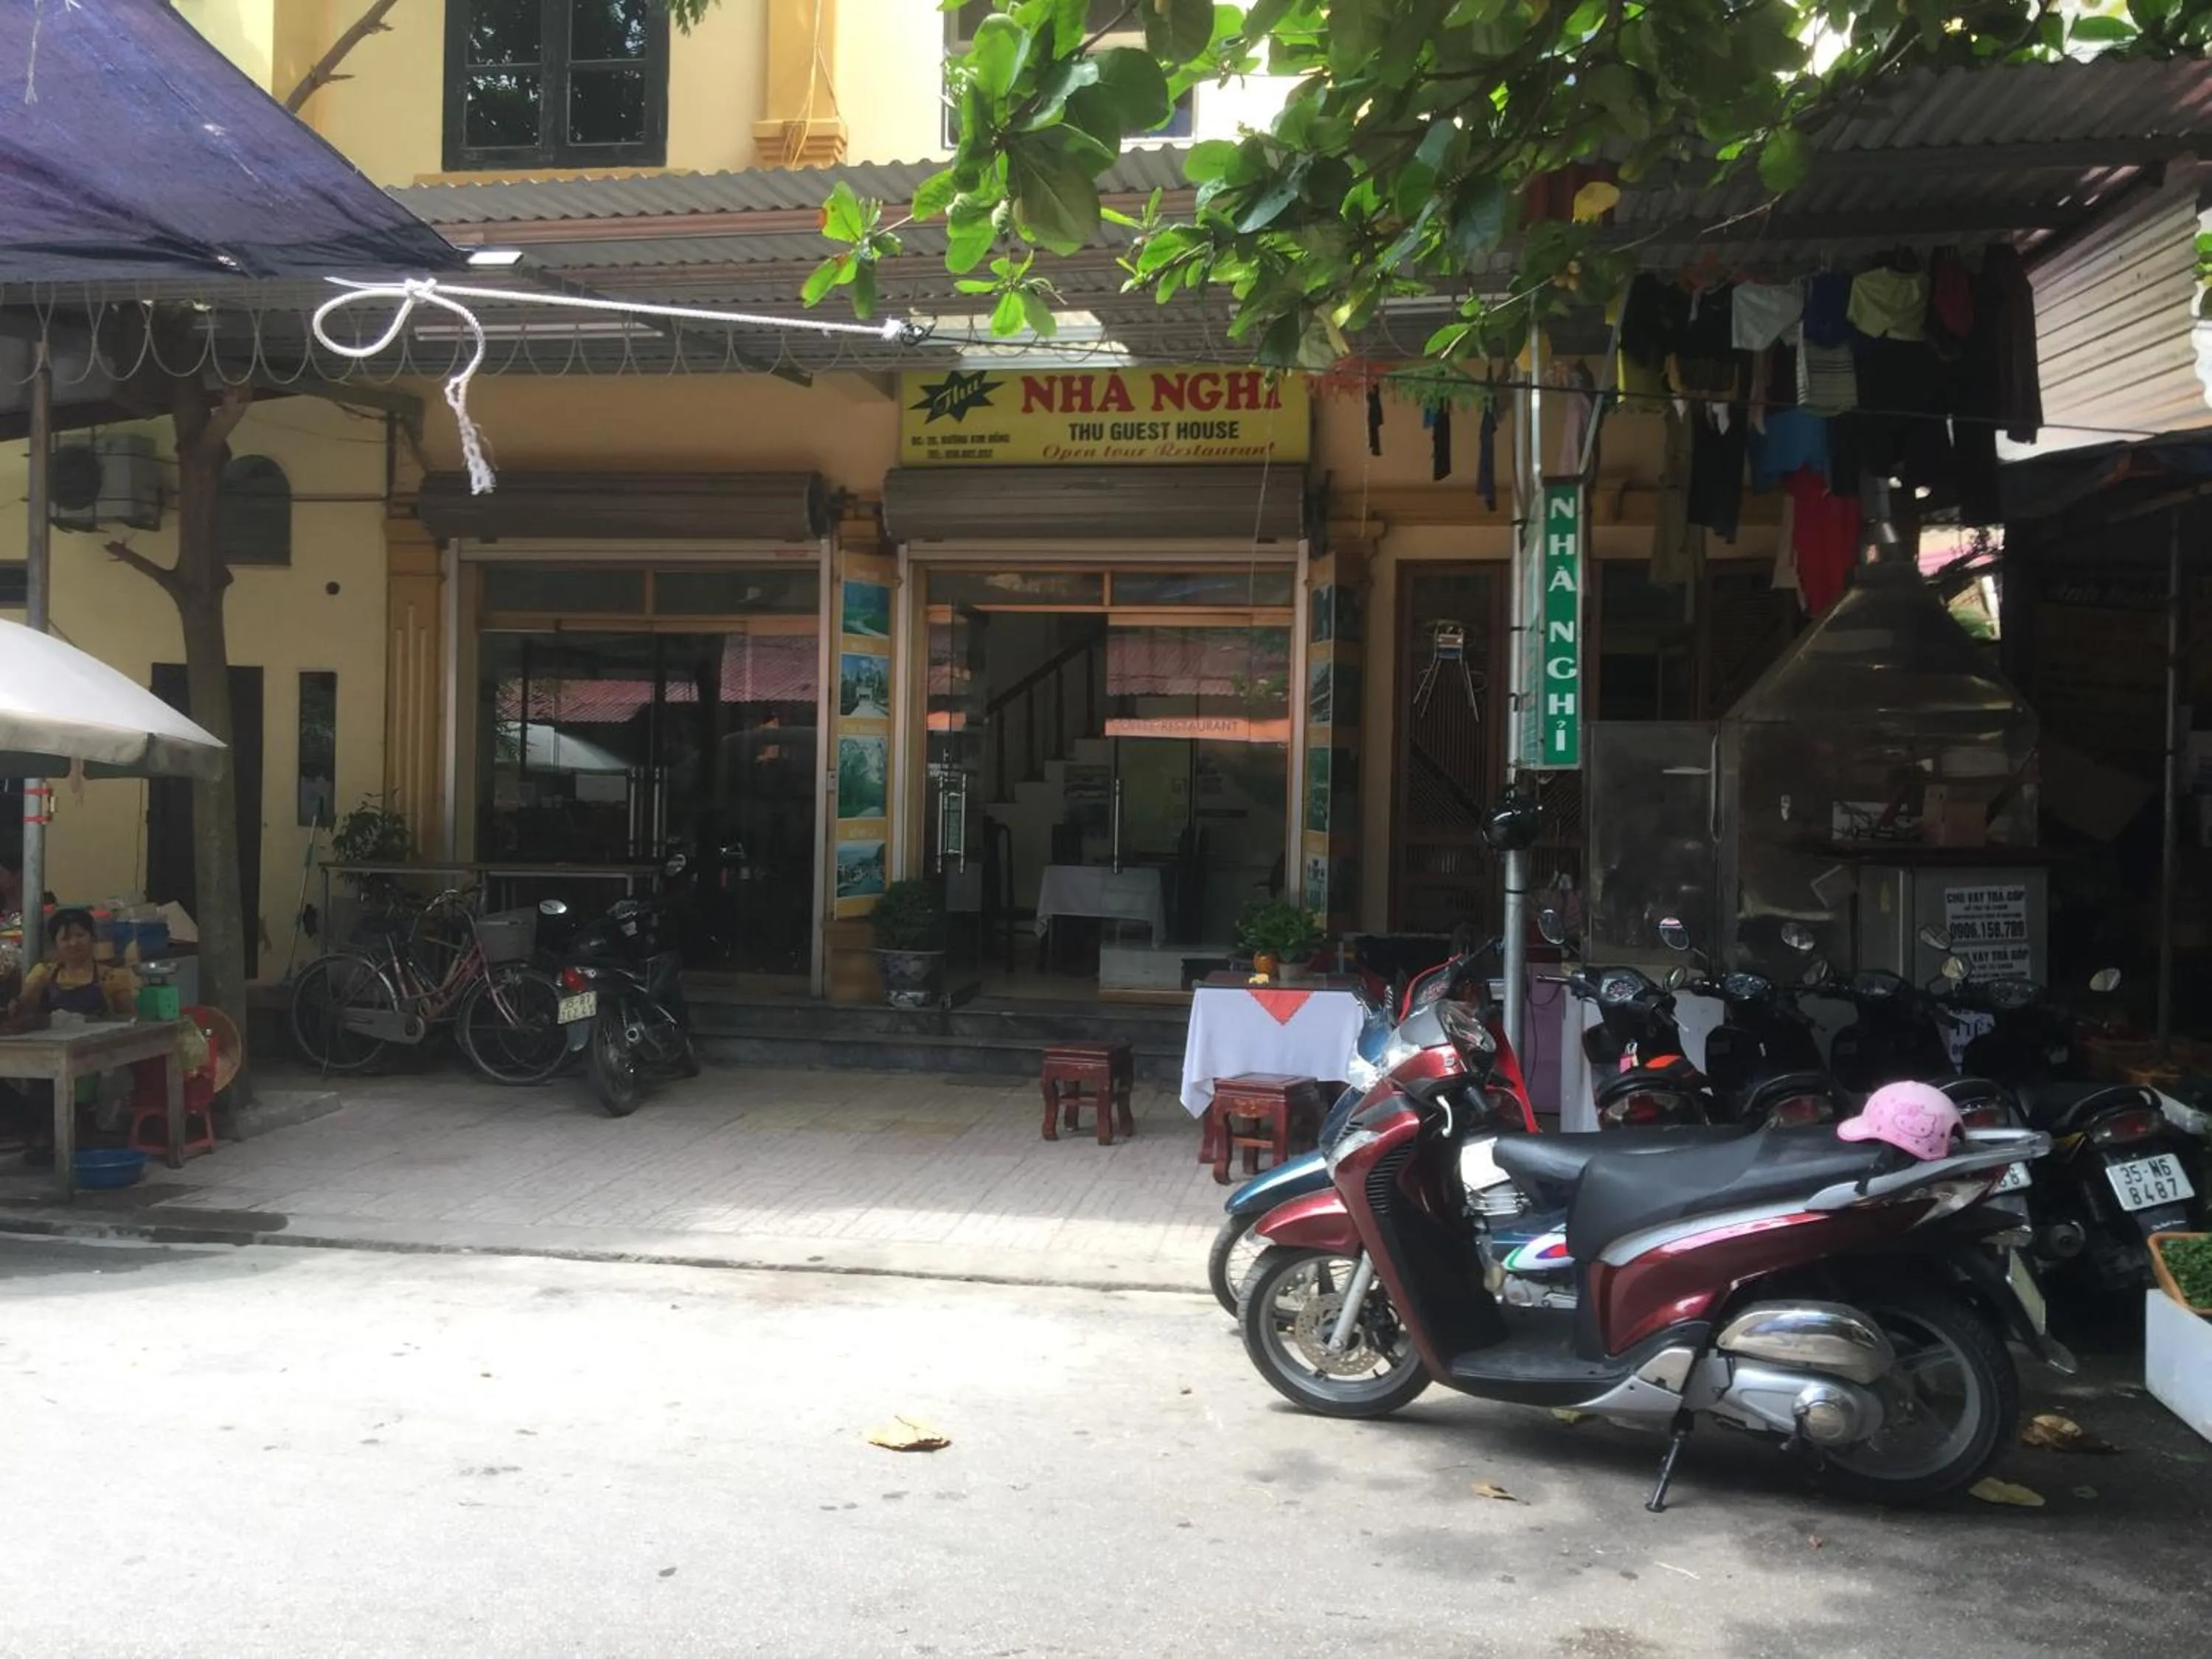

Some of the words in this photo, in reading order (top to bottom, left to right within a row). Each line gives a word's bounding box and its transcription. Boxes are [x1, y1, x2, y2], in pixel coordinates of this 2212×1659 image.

[1069, 422, 1105, 442] THU
[1110, 421, 1171, 441] GUEST
[1176, 420, 1239, 440] HOUSE
[1042, 443, 1096, 462] Open
[2128, 1178, 2178, 1206] 8487
